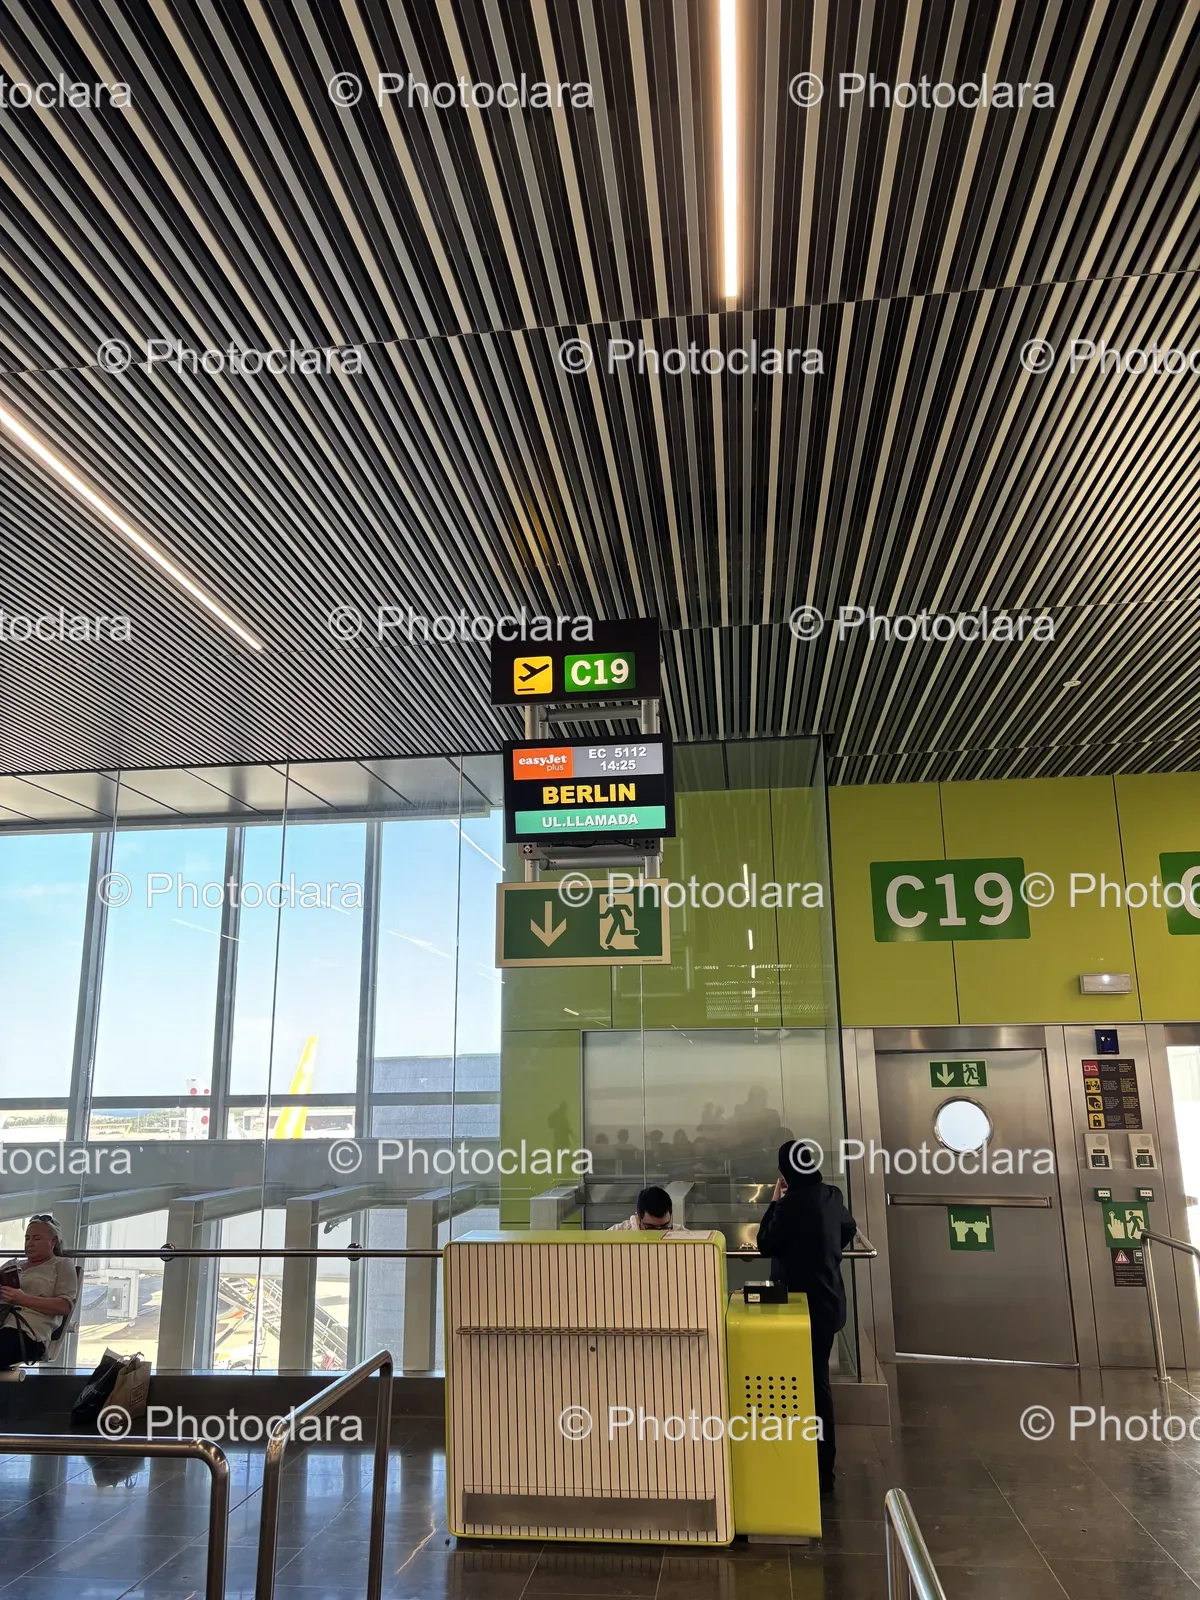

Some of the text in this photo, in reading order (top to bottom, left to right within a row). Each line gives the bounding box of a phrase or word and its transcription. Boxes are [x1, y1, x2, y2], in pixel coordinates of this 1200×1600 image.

[570, 658, 630, 686] C19
[588, 746, 647, 759] EC 5112
[518, 754, 567, 766] easyJet
[600, 760, 636, 771] 14:25
[546, 763, 564, 772] plus
[542, 783, 636, 805] BERLIN
[542, 813, 639, 828] UL.LLAMADA
[885, 872, 1014, 928] C19
